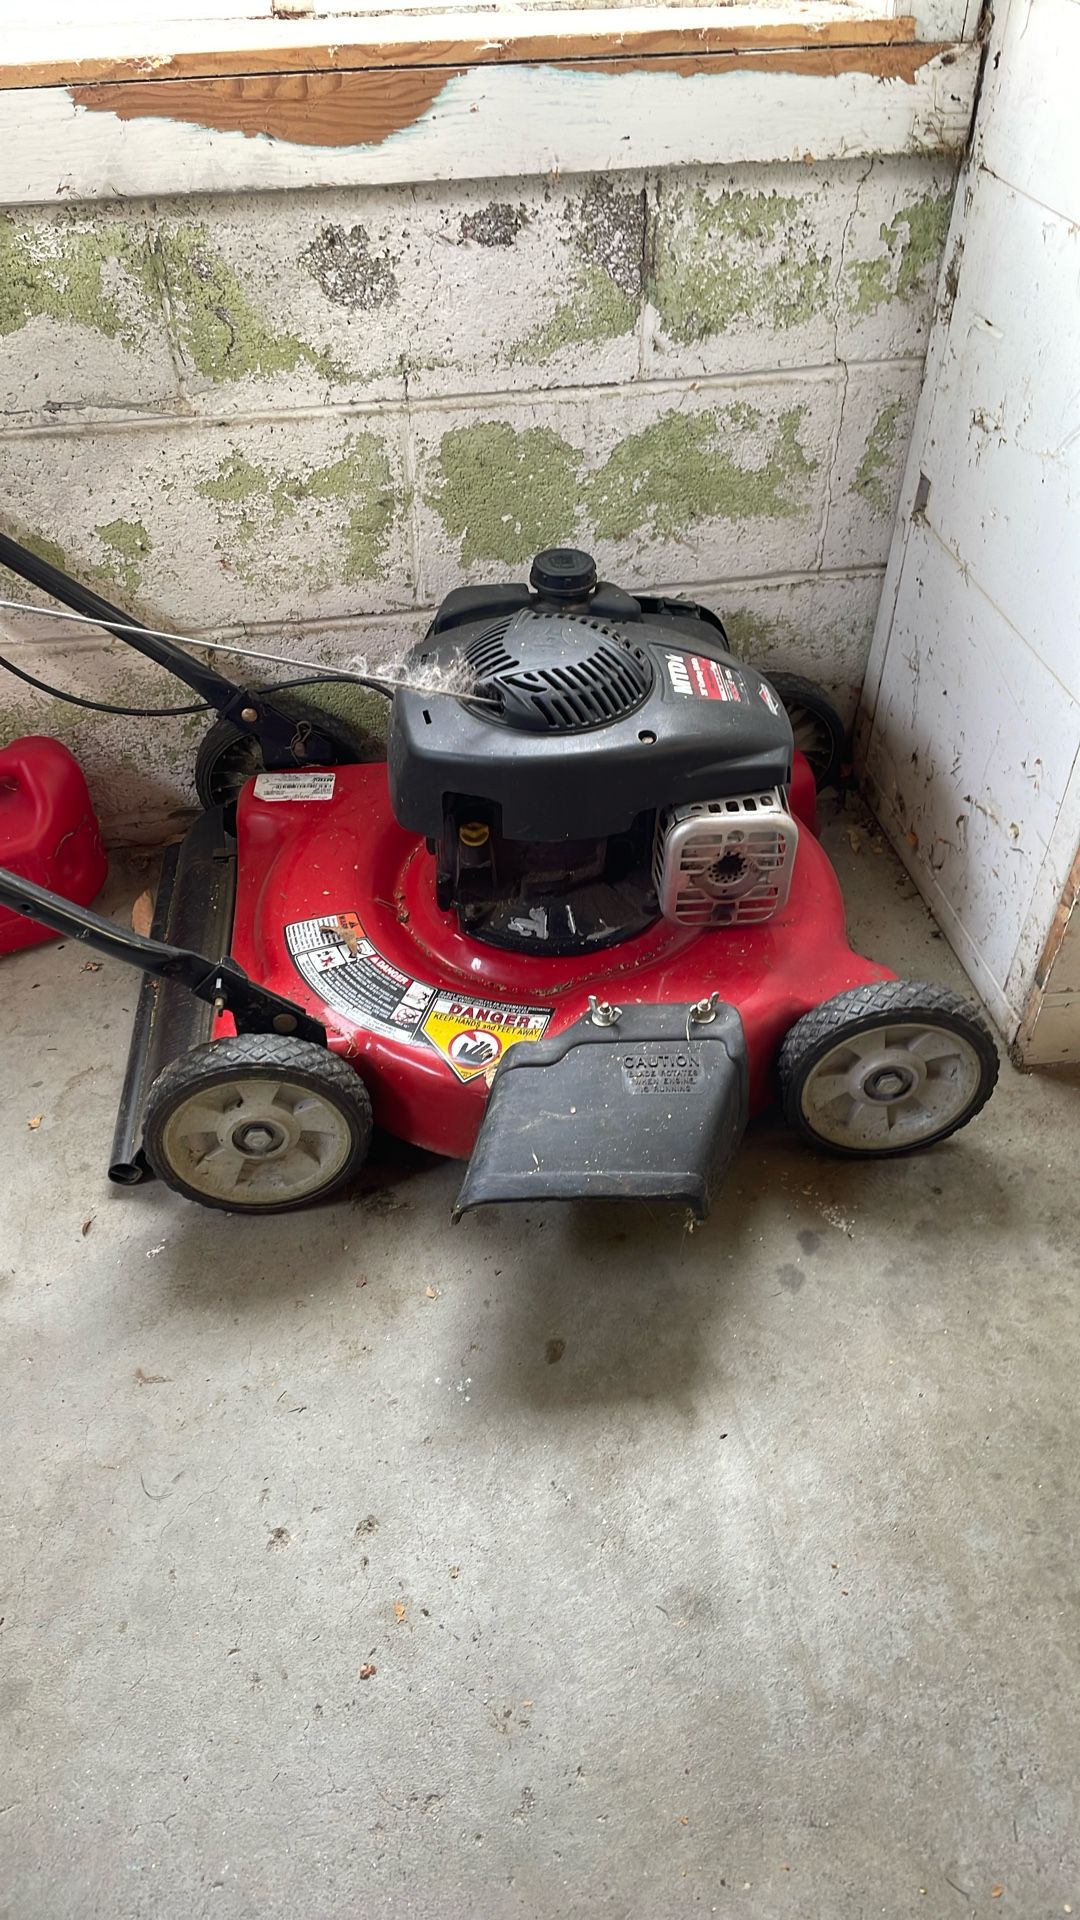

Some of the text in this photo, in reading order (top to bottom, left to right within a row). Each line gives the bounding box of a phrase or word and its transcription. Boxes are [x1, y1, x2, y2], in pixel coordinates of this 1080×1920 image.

[376, 956, 409, 984] DANGER
[433, 1013, 539, 1037] KEEP HANDS and FEET AWAY
[448, 1003, 530, 1028] DANGER
[624, 1056, 699, 1069] CAUTION
[661, 1069, 698, 1077] ROTATES
